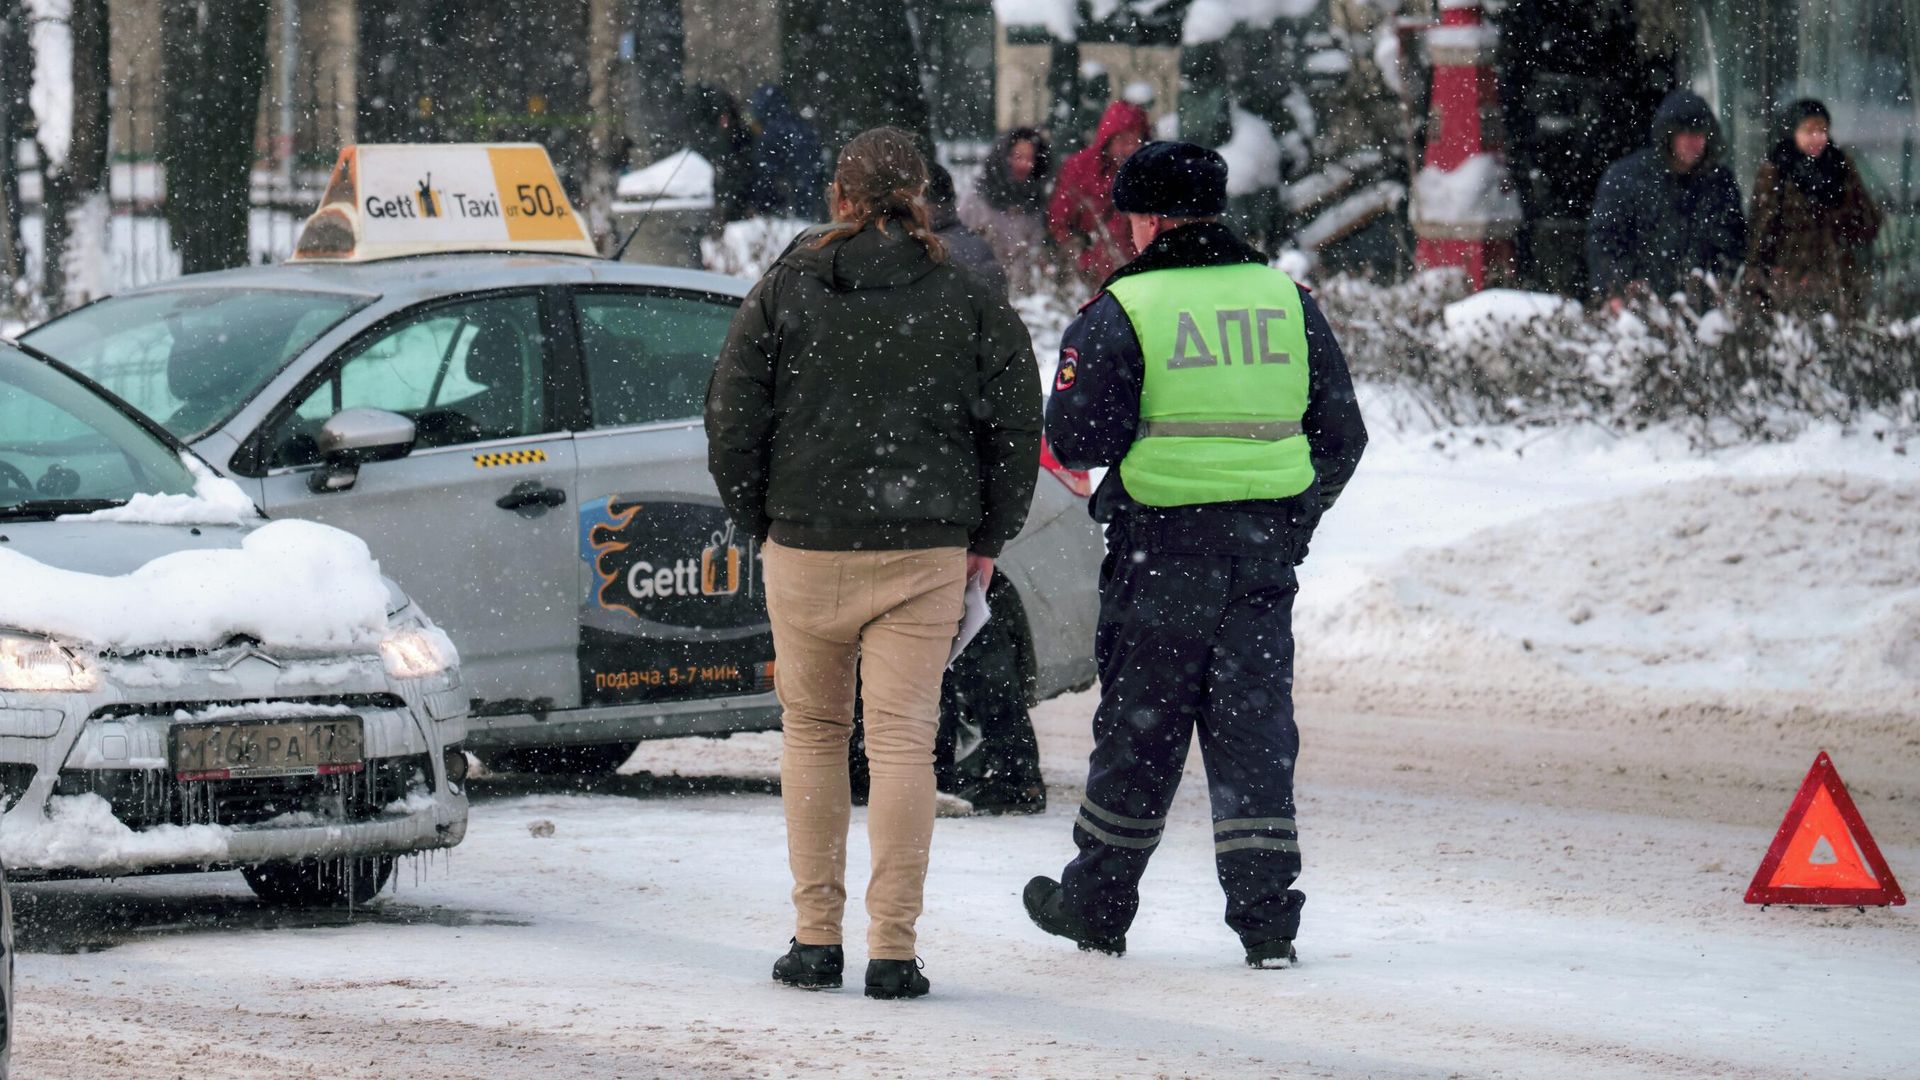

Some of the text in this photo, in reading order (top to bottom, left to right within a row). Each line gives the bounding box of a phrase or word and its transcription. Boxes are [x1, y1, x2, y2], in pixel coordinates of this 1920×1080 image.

[365, 192, 499, 219] Gett Taxi
[517, 184, 554, 217] 50
[1167, 309, 1290, 369] ДПС
[626, 558, 700, 599] Gett
[596, 671, 660, 690] подача
